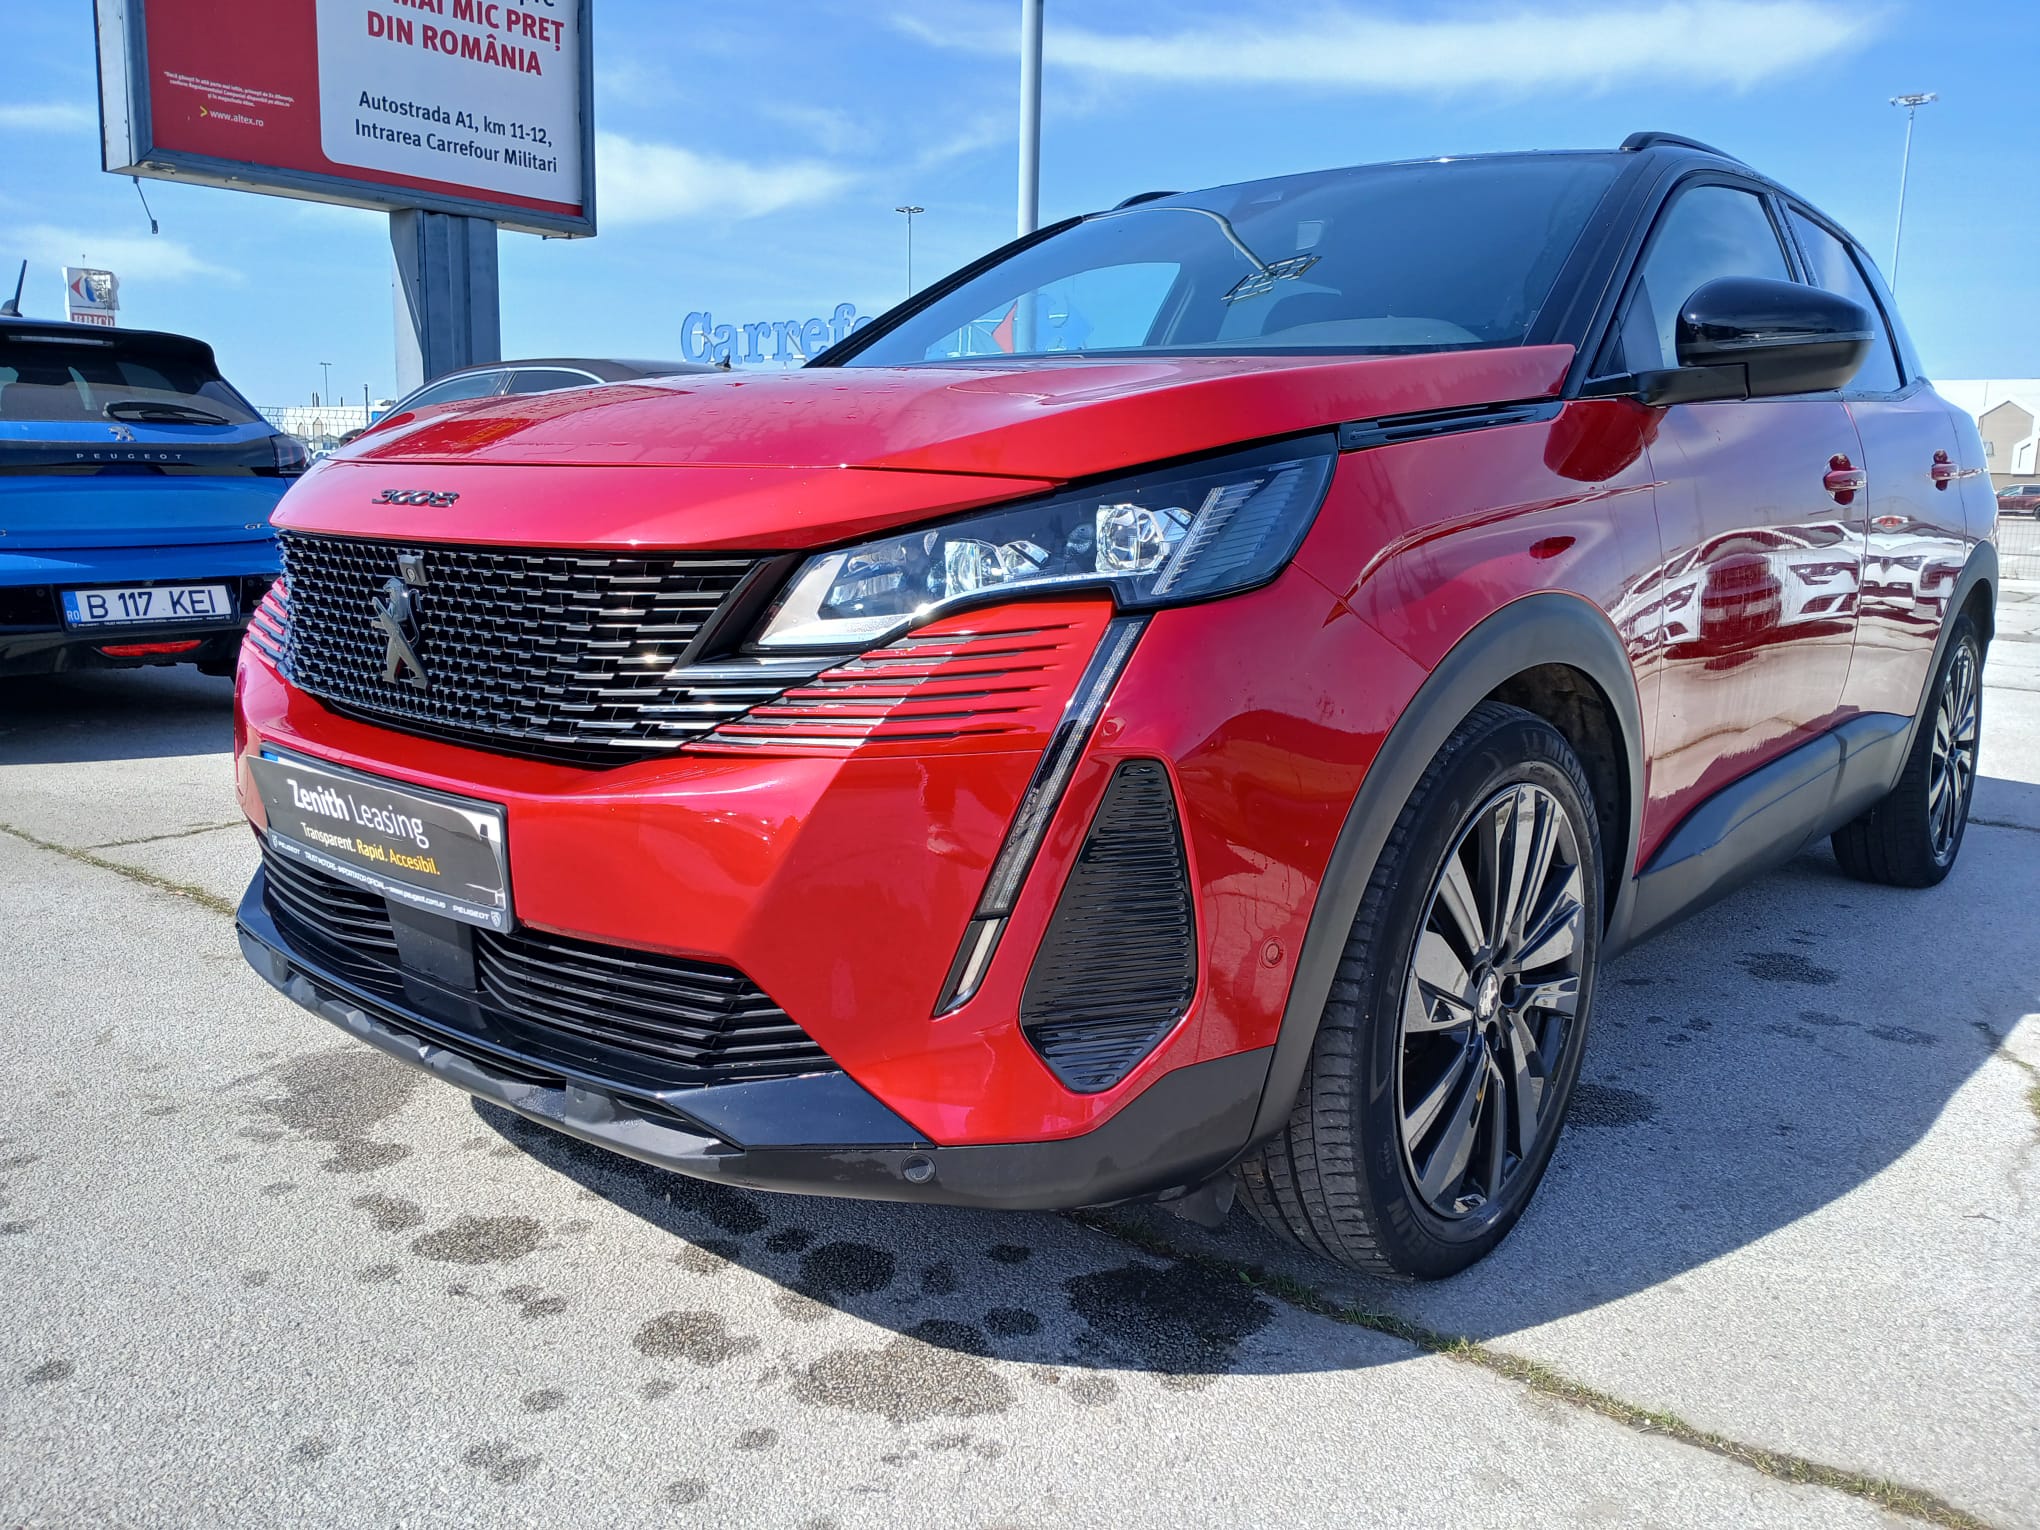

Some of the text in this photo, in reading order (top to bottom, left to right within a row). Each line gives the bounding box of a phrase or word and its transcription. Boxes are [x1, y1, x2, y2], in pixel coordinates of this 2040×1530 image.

[367, 10, 542, 76] DIN ROMÂNIA
[452, 0, 500, 29] MIC
[506, 8, 565, 52] PREȚ
[209, 110, 264, 127] www.altex.ro
[358, 90, 553, 148] Autostrada A1, km 11-12,
[355, 118, 558, 173] Intrarea Carrefour Militari
[371, 488, 461, 508] 3008
[66, 610, 81, 622] RO
[86, 589, 216, 620] B 117 KEI
[286, 778, 430, 849] Zenith Leasing
[300, 821, 441, 875] Transparent. Rapid. Accesibil.
[452, 905, 490, 920] PEUGEOT
